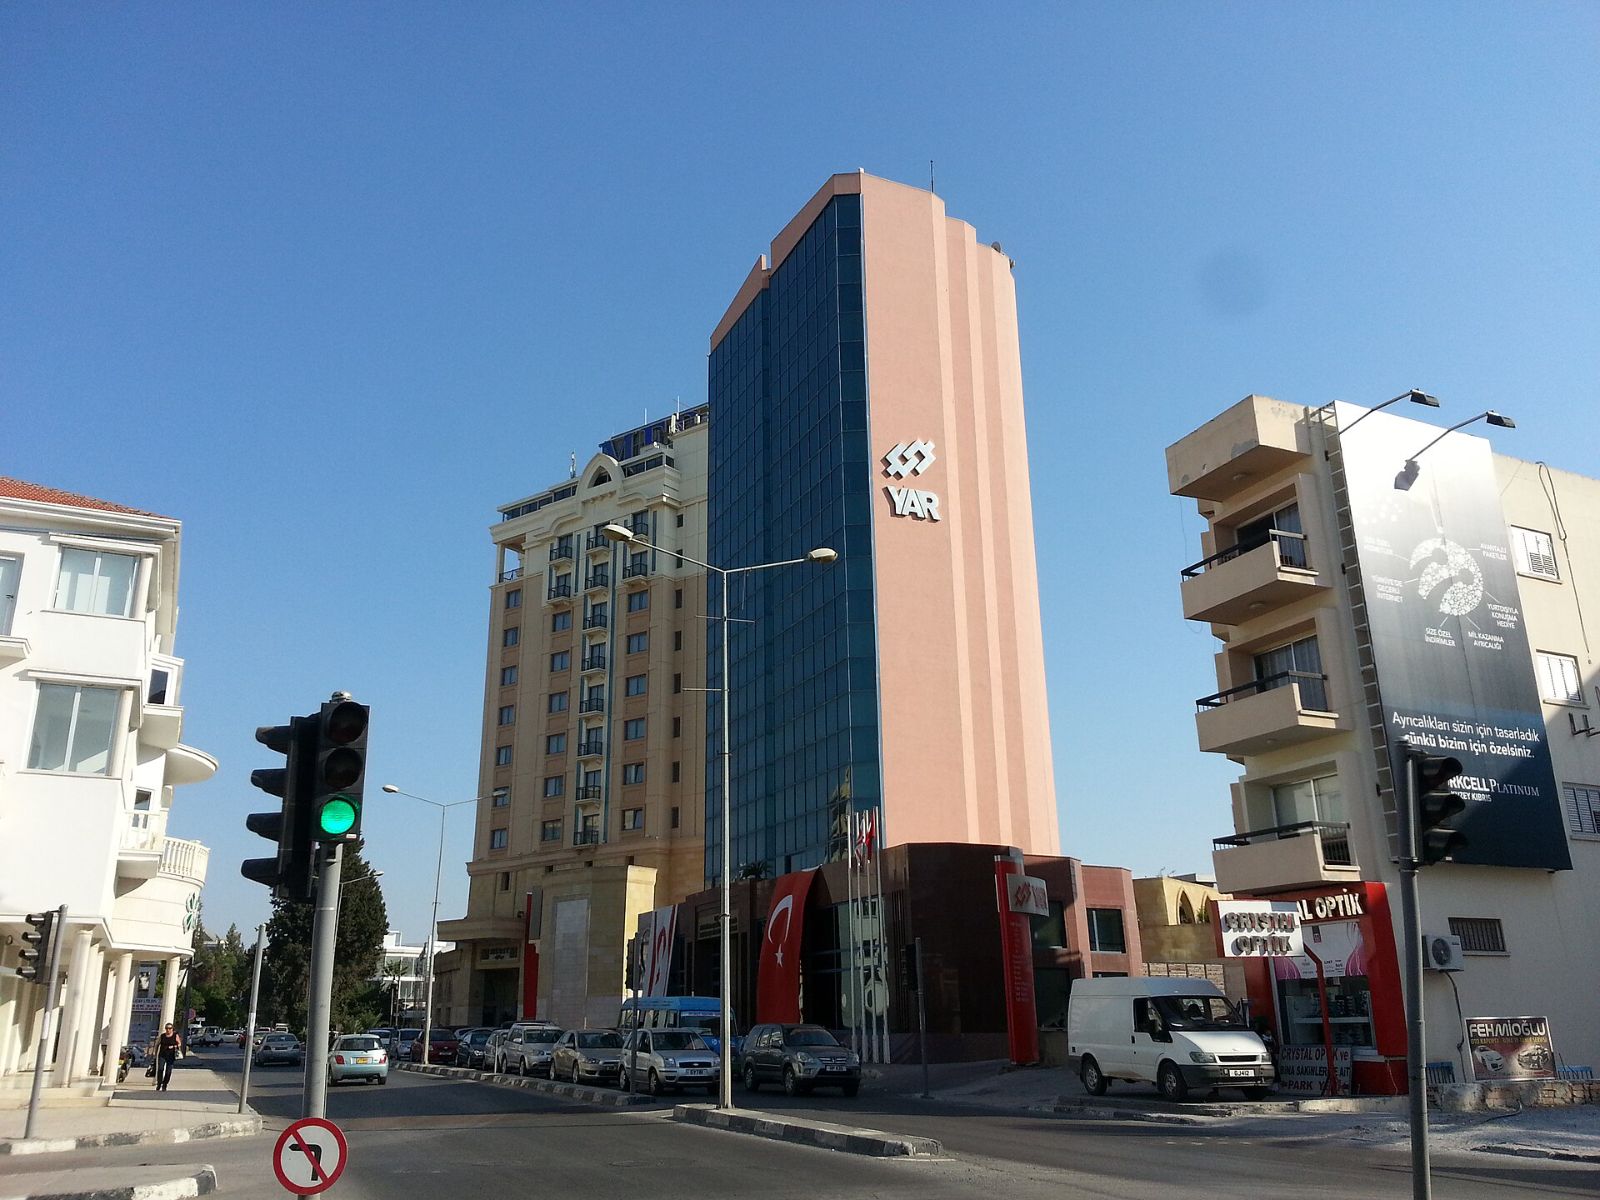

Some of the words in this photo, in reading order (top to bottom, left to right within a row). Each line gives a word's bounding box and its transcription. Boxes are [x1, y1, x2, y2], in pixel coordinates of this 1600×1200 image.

[884, 485, 941, 521] YAR
[1392, 711, 1450, 731] Ayrıcalıkları
[1452, 720, 1473, 734] sizin
[1475, 722, 1493, 738] için
[1494, 726, 1540, 742] tasarladık
[1438, 734, 1467, 751] bizim
[1469, 738, 1487, 756] için
[1489, 742, 1535, 758] özelsiniz.
[1448, 775, 1490, 791] RKCELL
[1315, 888, 1363, 919] OPTİK
[1222, 912, 1299, 932] CRYSTAL
[1469, 1020, 1546, 1038] FEHMİOĞLU
[1281, 1047, 1312, 1060] CRYSTAL
[1287, 1080, 1313, 1091] PARK
